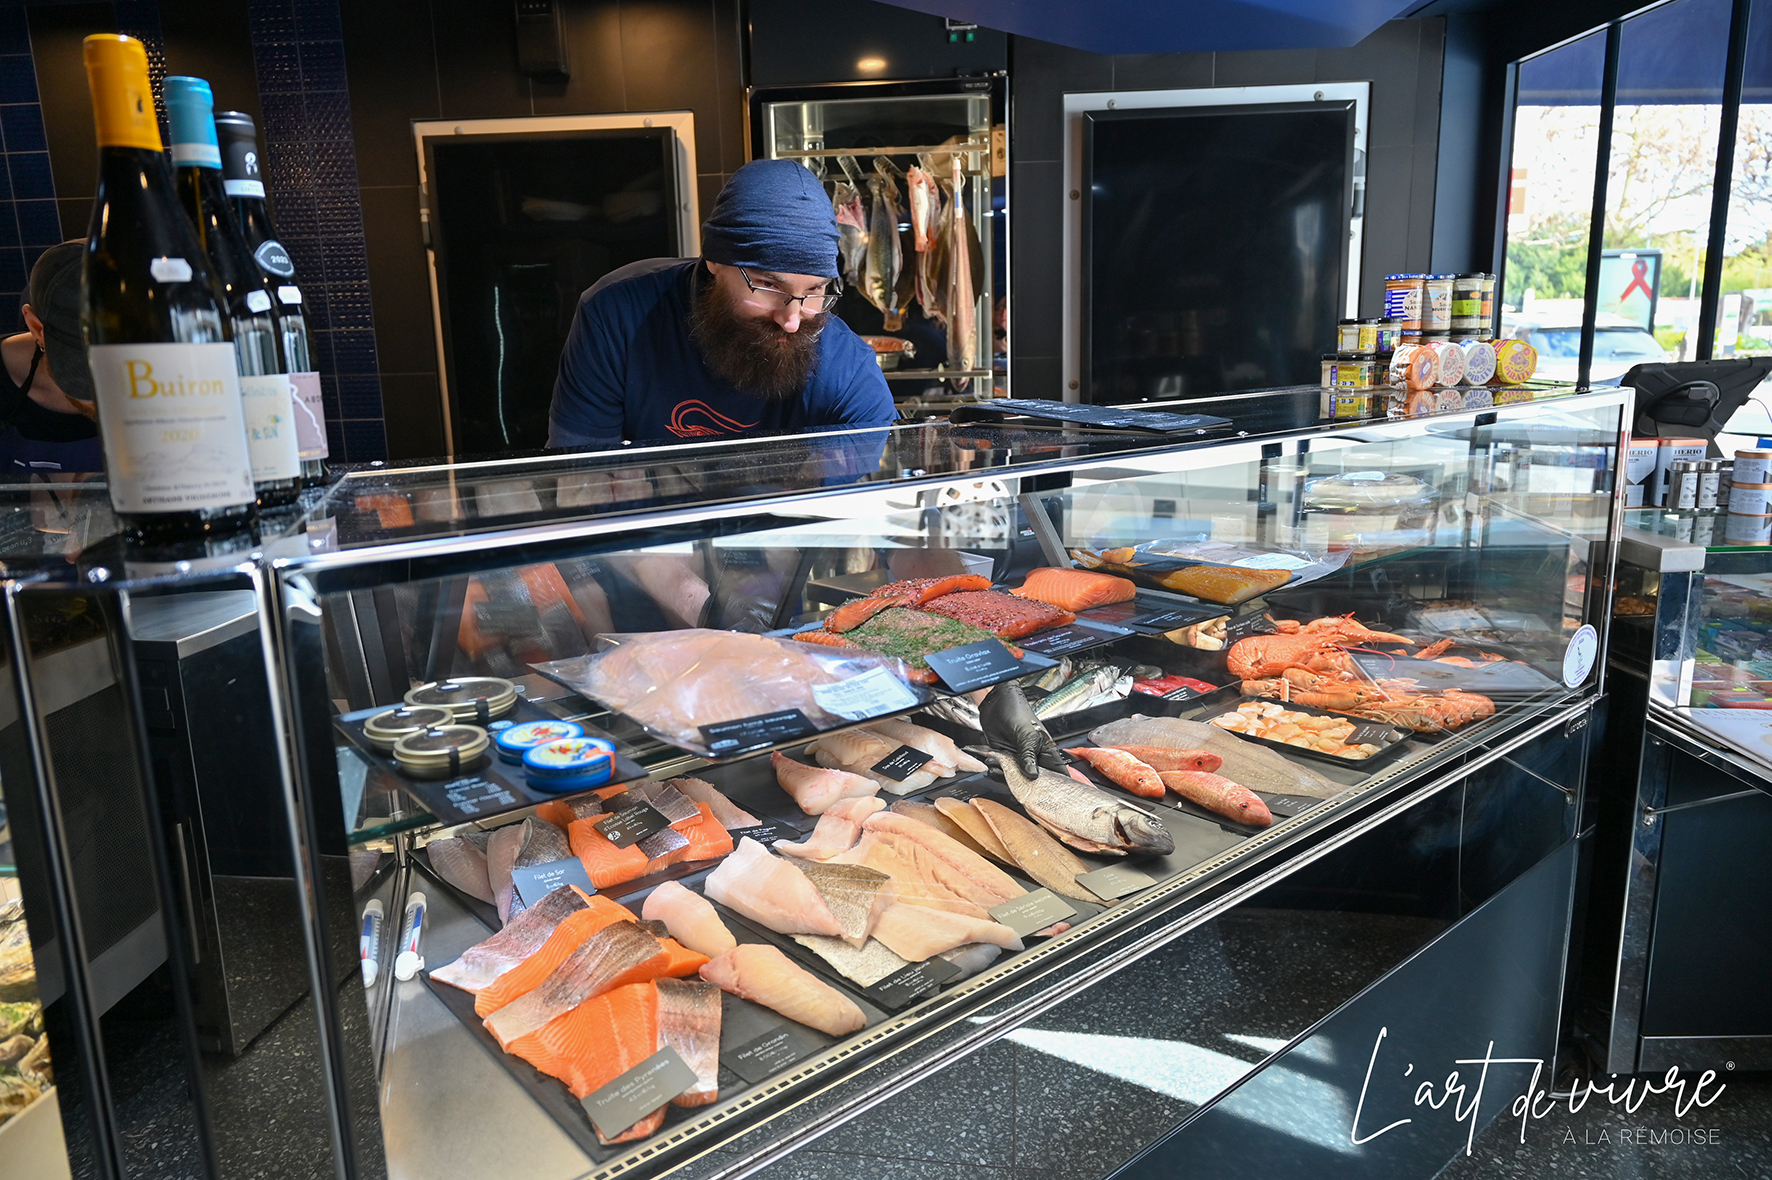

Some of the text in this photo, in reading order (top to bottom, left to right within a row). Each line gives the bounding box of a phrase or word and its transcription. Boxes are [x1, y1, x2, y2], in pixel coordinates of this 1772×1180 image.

[125, 359, 225, 399] Buiron
[946, 649, 991, 665] Truite Gravlax
[737, 1050, 753, 1060] Filet
[761, 1033, 789, 1048] Grondin
[596, 1091, 620, 1107] Truite
[620, 1081, 635, 1093] des
